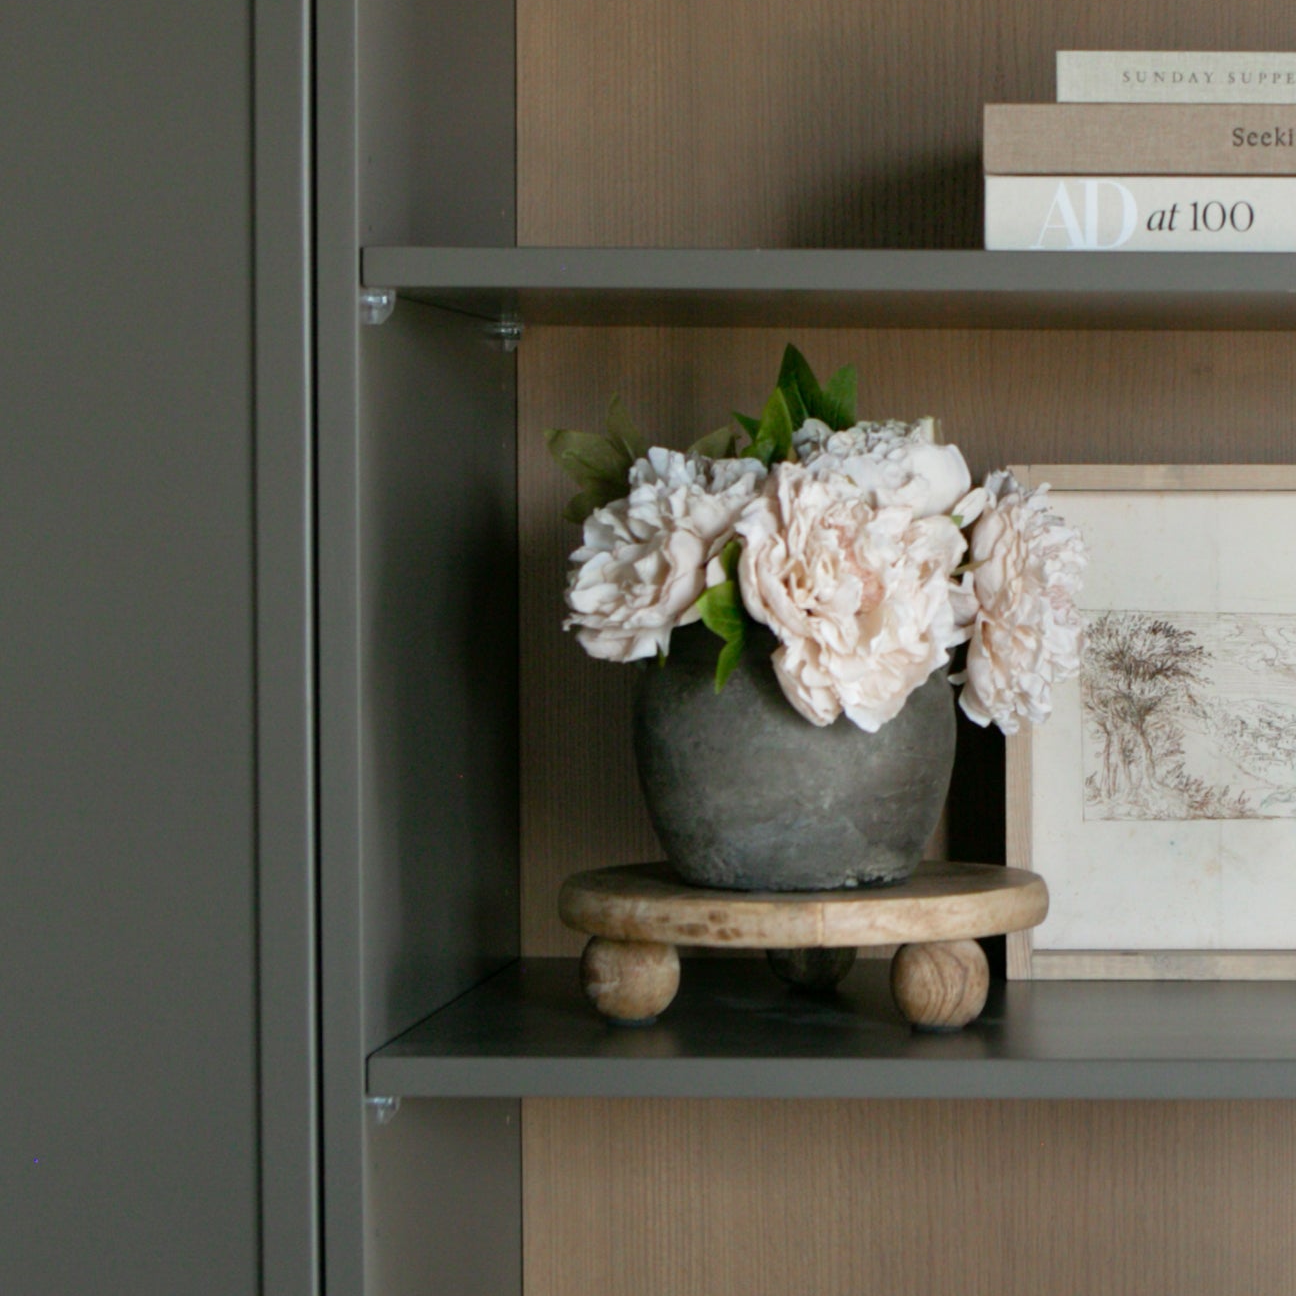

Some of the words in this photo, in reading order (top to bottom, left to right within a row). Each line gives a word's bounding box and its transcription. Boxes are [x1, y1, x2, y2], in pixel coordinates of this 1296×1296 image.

[1123, 71, 1215, 84] SUNDAY
[1029, 179, 1138, 250] AD
[1146, 203, 1180, 231] at
[1189, 201, 1255, 232] 100
